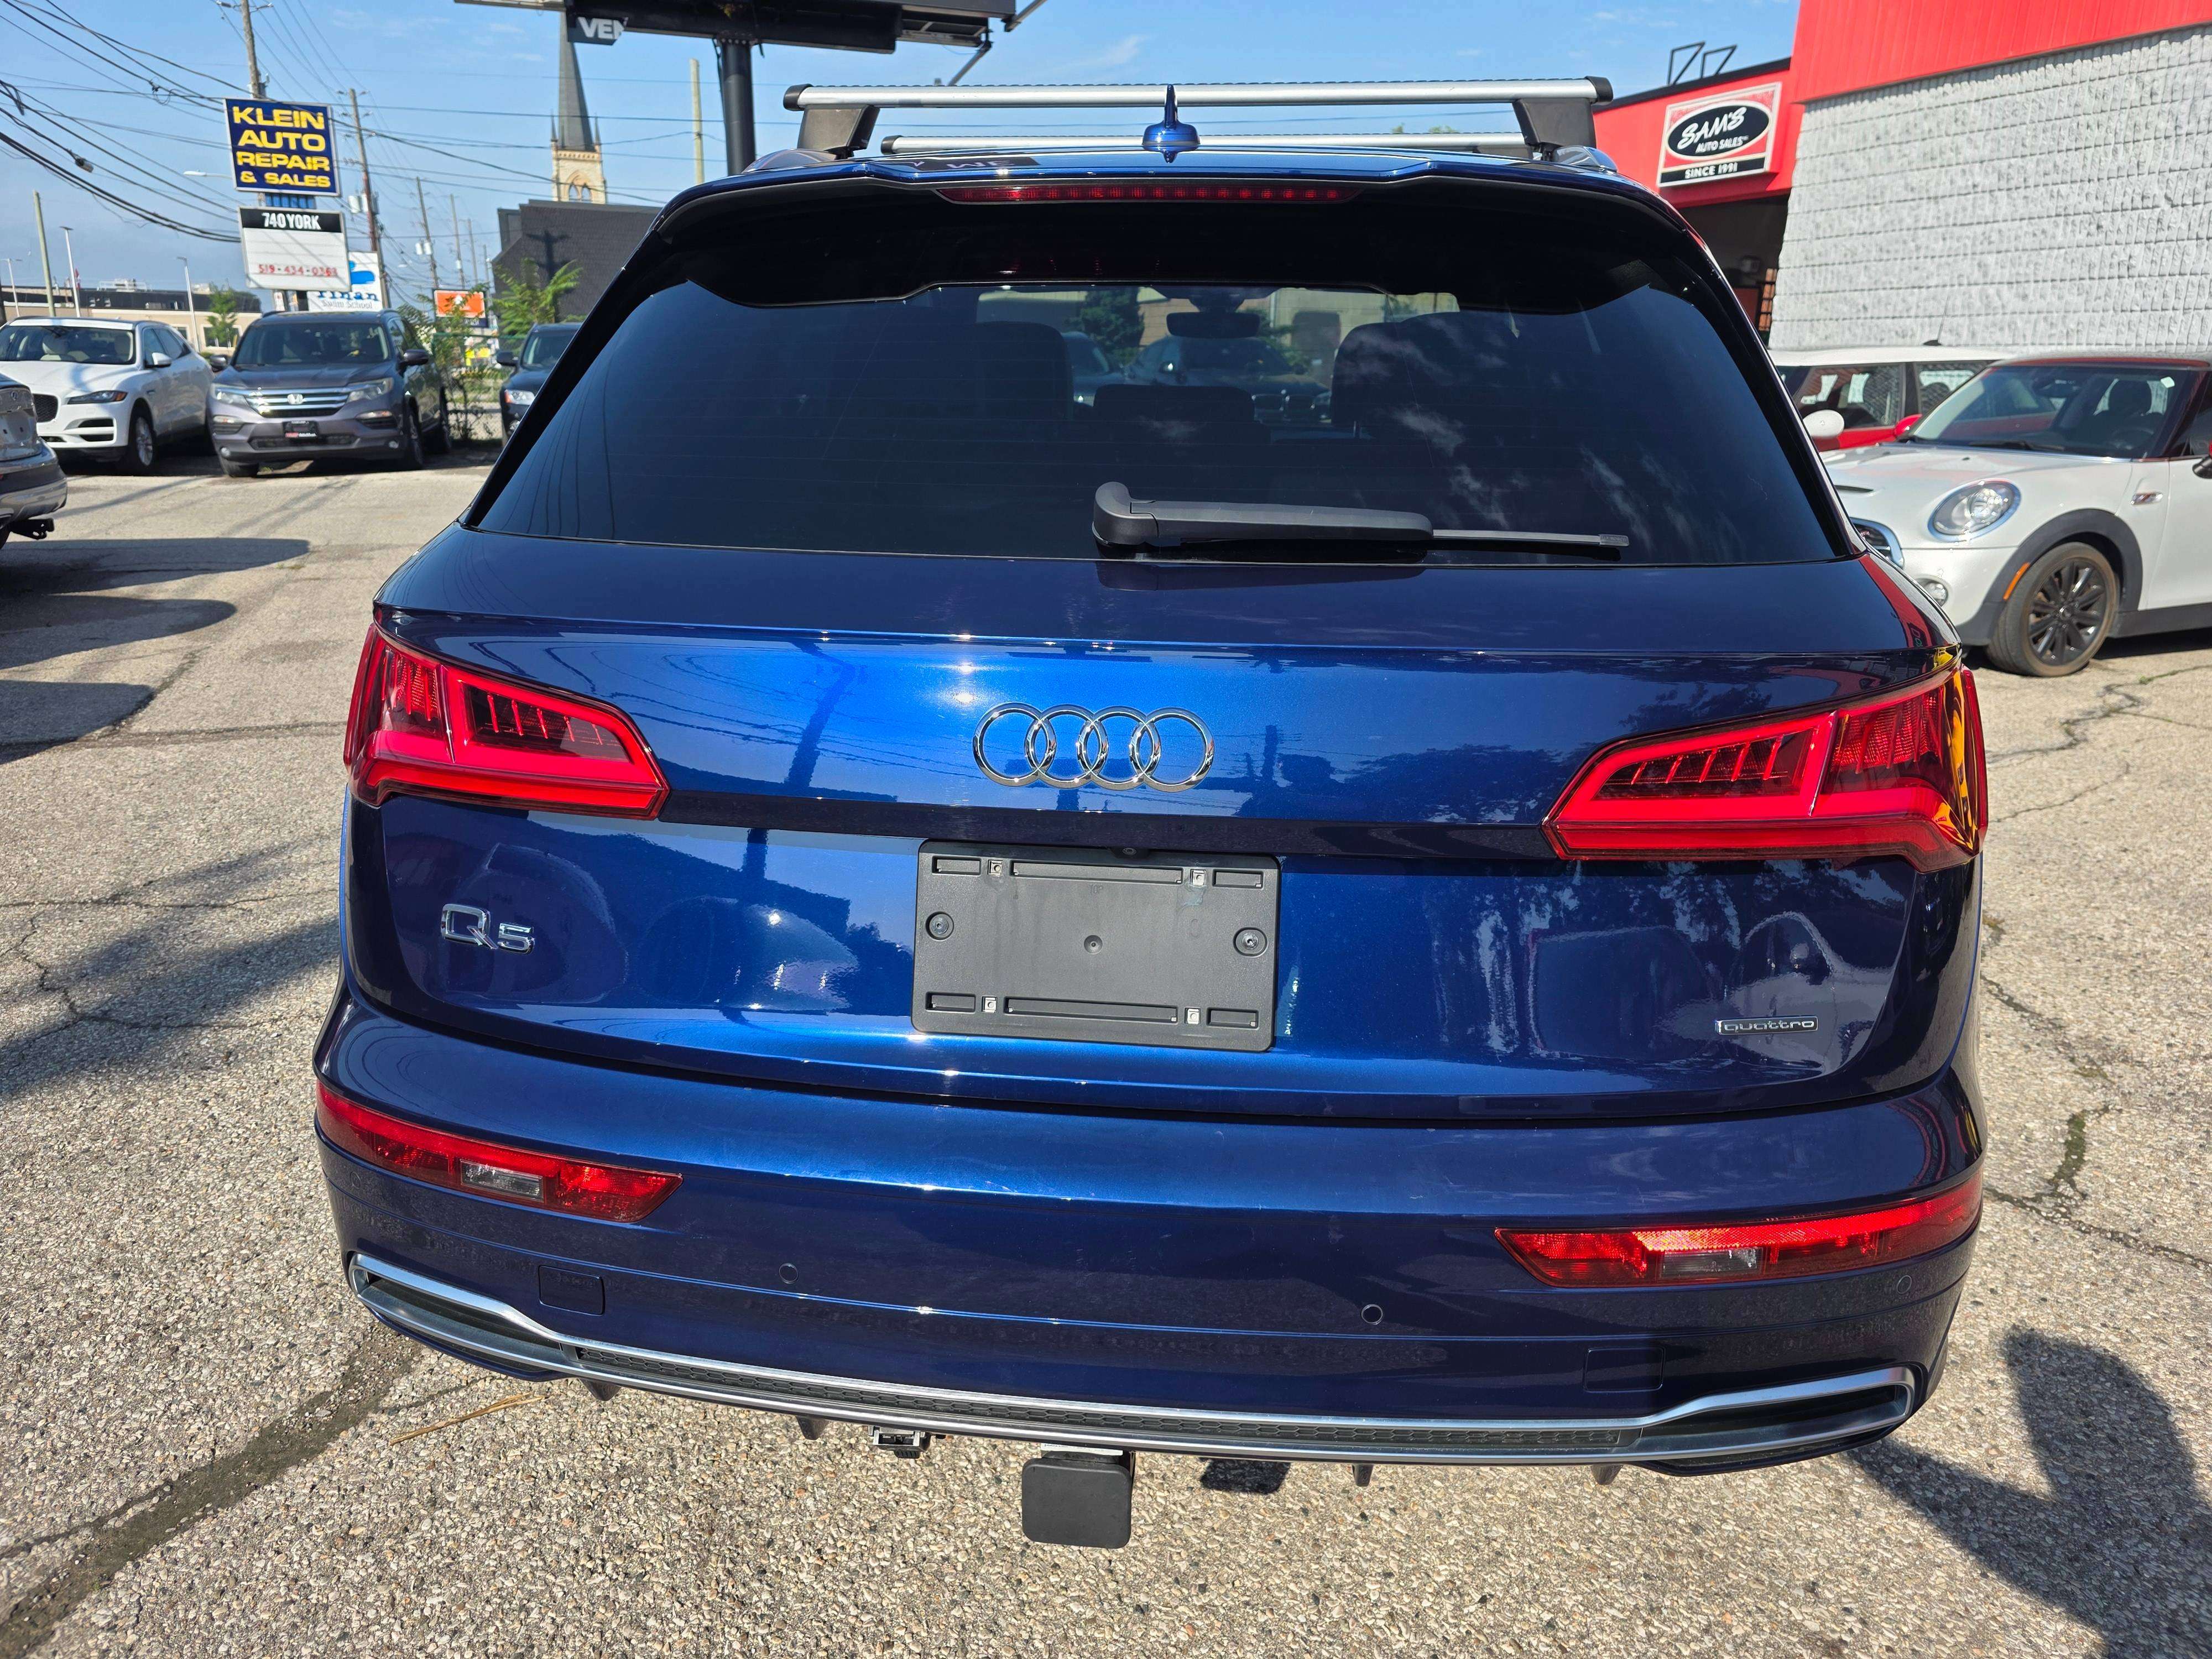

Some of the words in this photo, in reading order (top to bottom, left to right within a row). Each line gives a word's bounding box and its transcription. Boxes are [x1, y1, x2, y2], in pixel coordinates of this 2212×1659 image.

[232, 106, 325, 129] KLEIN
[1677, 107, 1747, 149] SAM'S
[238, 129, 326, 152] AUTO
[1695, 140, 1719, 154] AUTO
[1718, 137, 1743, 150] SALES
[236, 151, 330, 171] REPAIR
[1684, 165, 1715, 179] SINCE
[1718, 162, 1738, 174] 1991
[240, 171, 257, 183] &
[265, 172, 331, 187] SALES
[262, 212, 286, 228] 740
[286, 213, 321, 230] YORK
[441, 904, 535, 954] Q5
[1724, 1019, 1814, 1032] quattro
